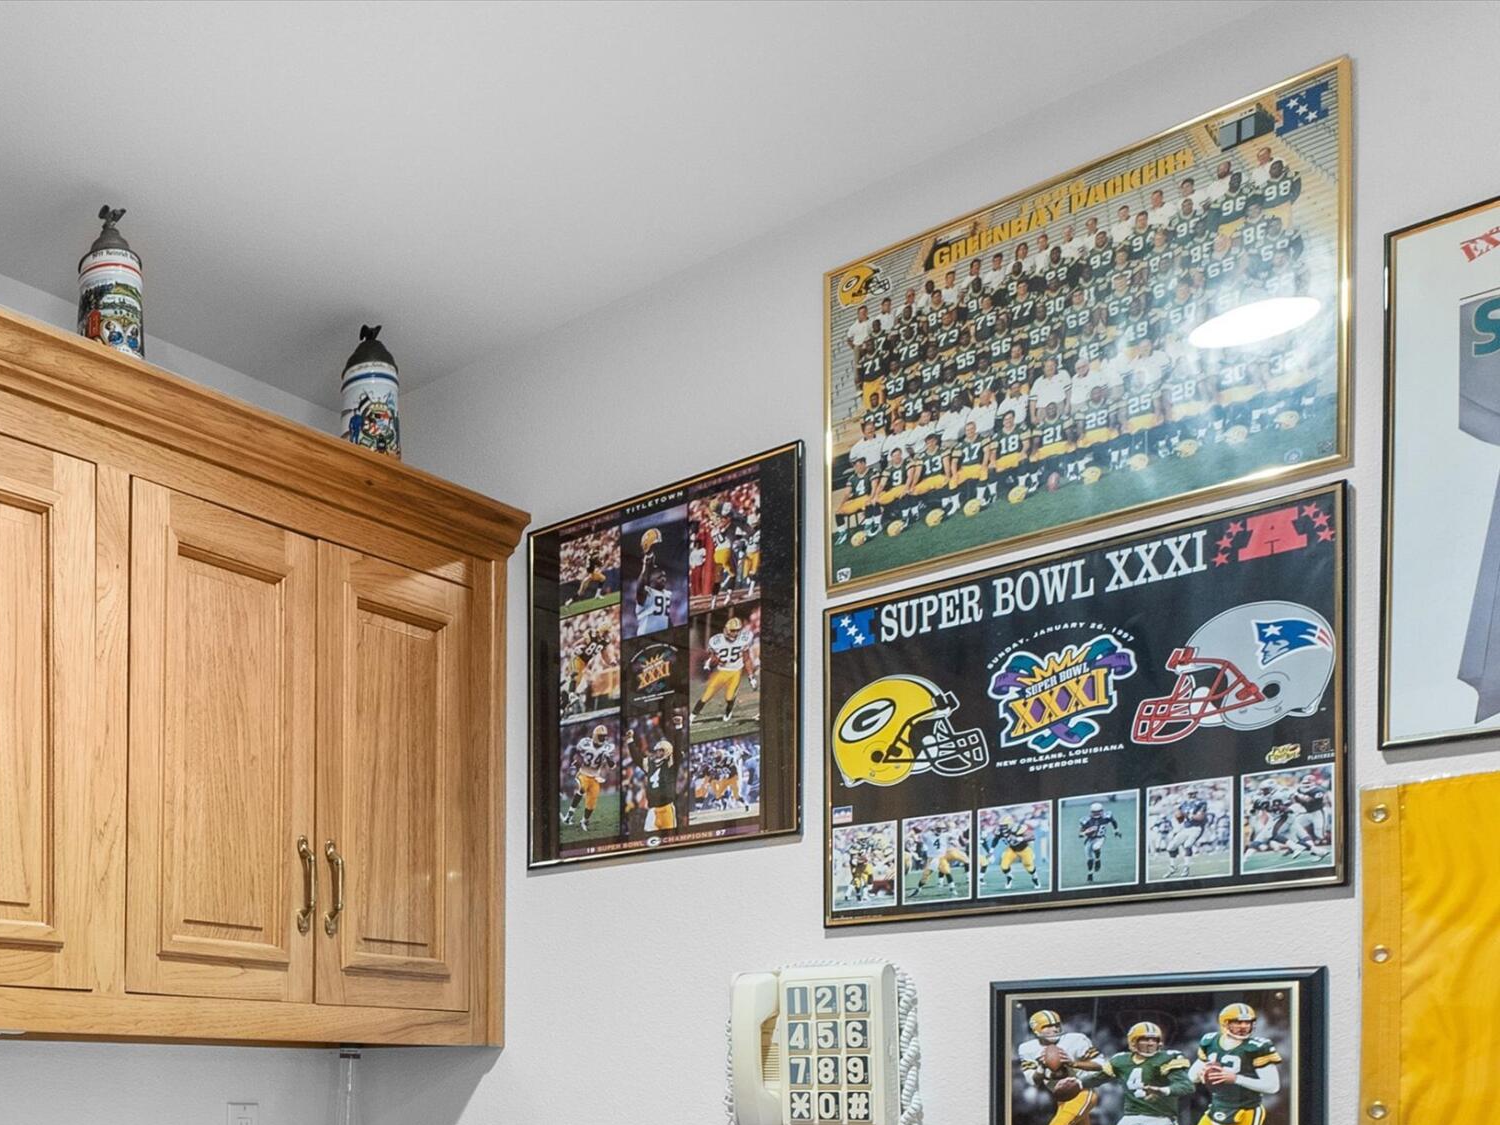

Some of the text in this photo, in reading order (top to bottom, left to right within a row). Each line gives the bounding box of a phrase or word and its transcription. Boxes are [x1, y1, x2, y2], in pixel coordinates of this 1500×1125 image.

[625, 490, 684, 514] TITLETOWN
[880, 530, 1207, 643] SUPER BOWL XXXI
[717, 648, 742, 664] 25
[987, 637, 1030, 669] SUNDAY,
[1033, 622, 1086, 639] JANUARY
[1025, 662, 1090, 698] SUPER BOWL
[1009, 667, 1109, 737] XXXI
[995, 743, 1125, 768] NEW ORLEANS, LOUISIANA
[1029, 758, 1089, 772] SUPERDOME
[663, 832, 713, 844] CHAMPIONS
[794, 985, 862, 1014] 1 2 3
[789, 1021, 864, 1049] 4 5 6
[790, 1057, 864, 1083] 7 8 9
[818, 1093, 835, 1119] 0
